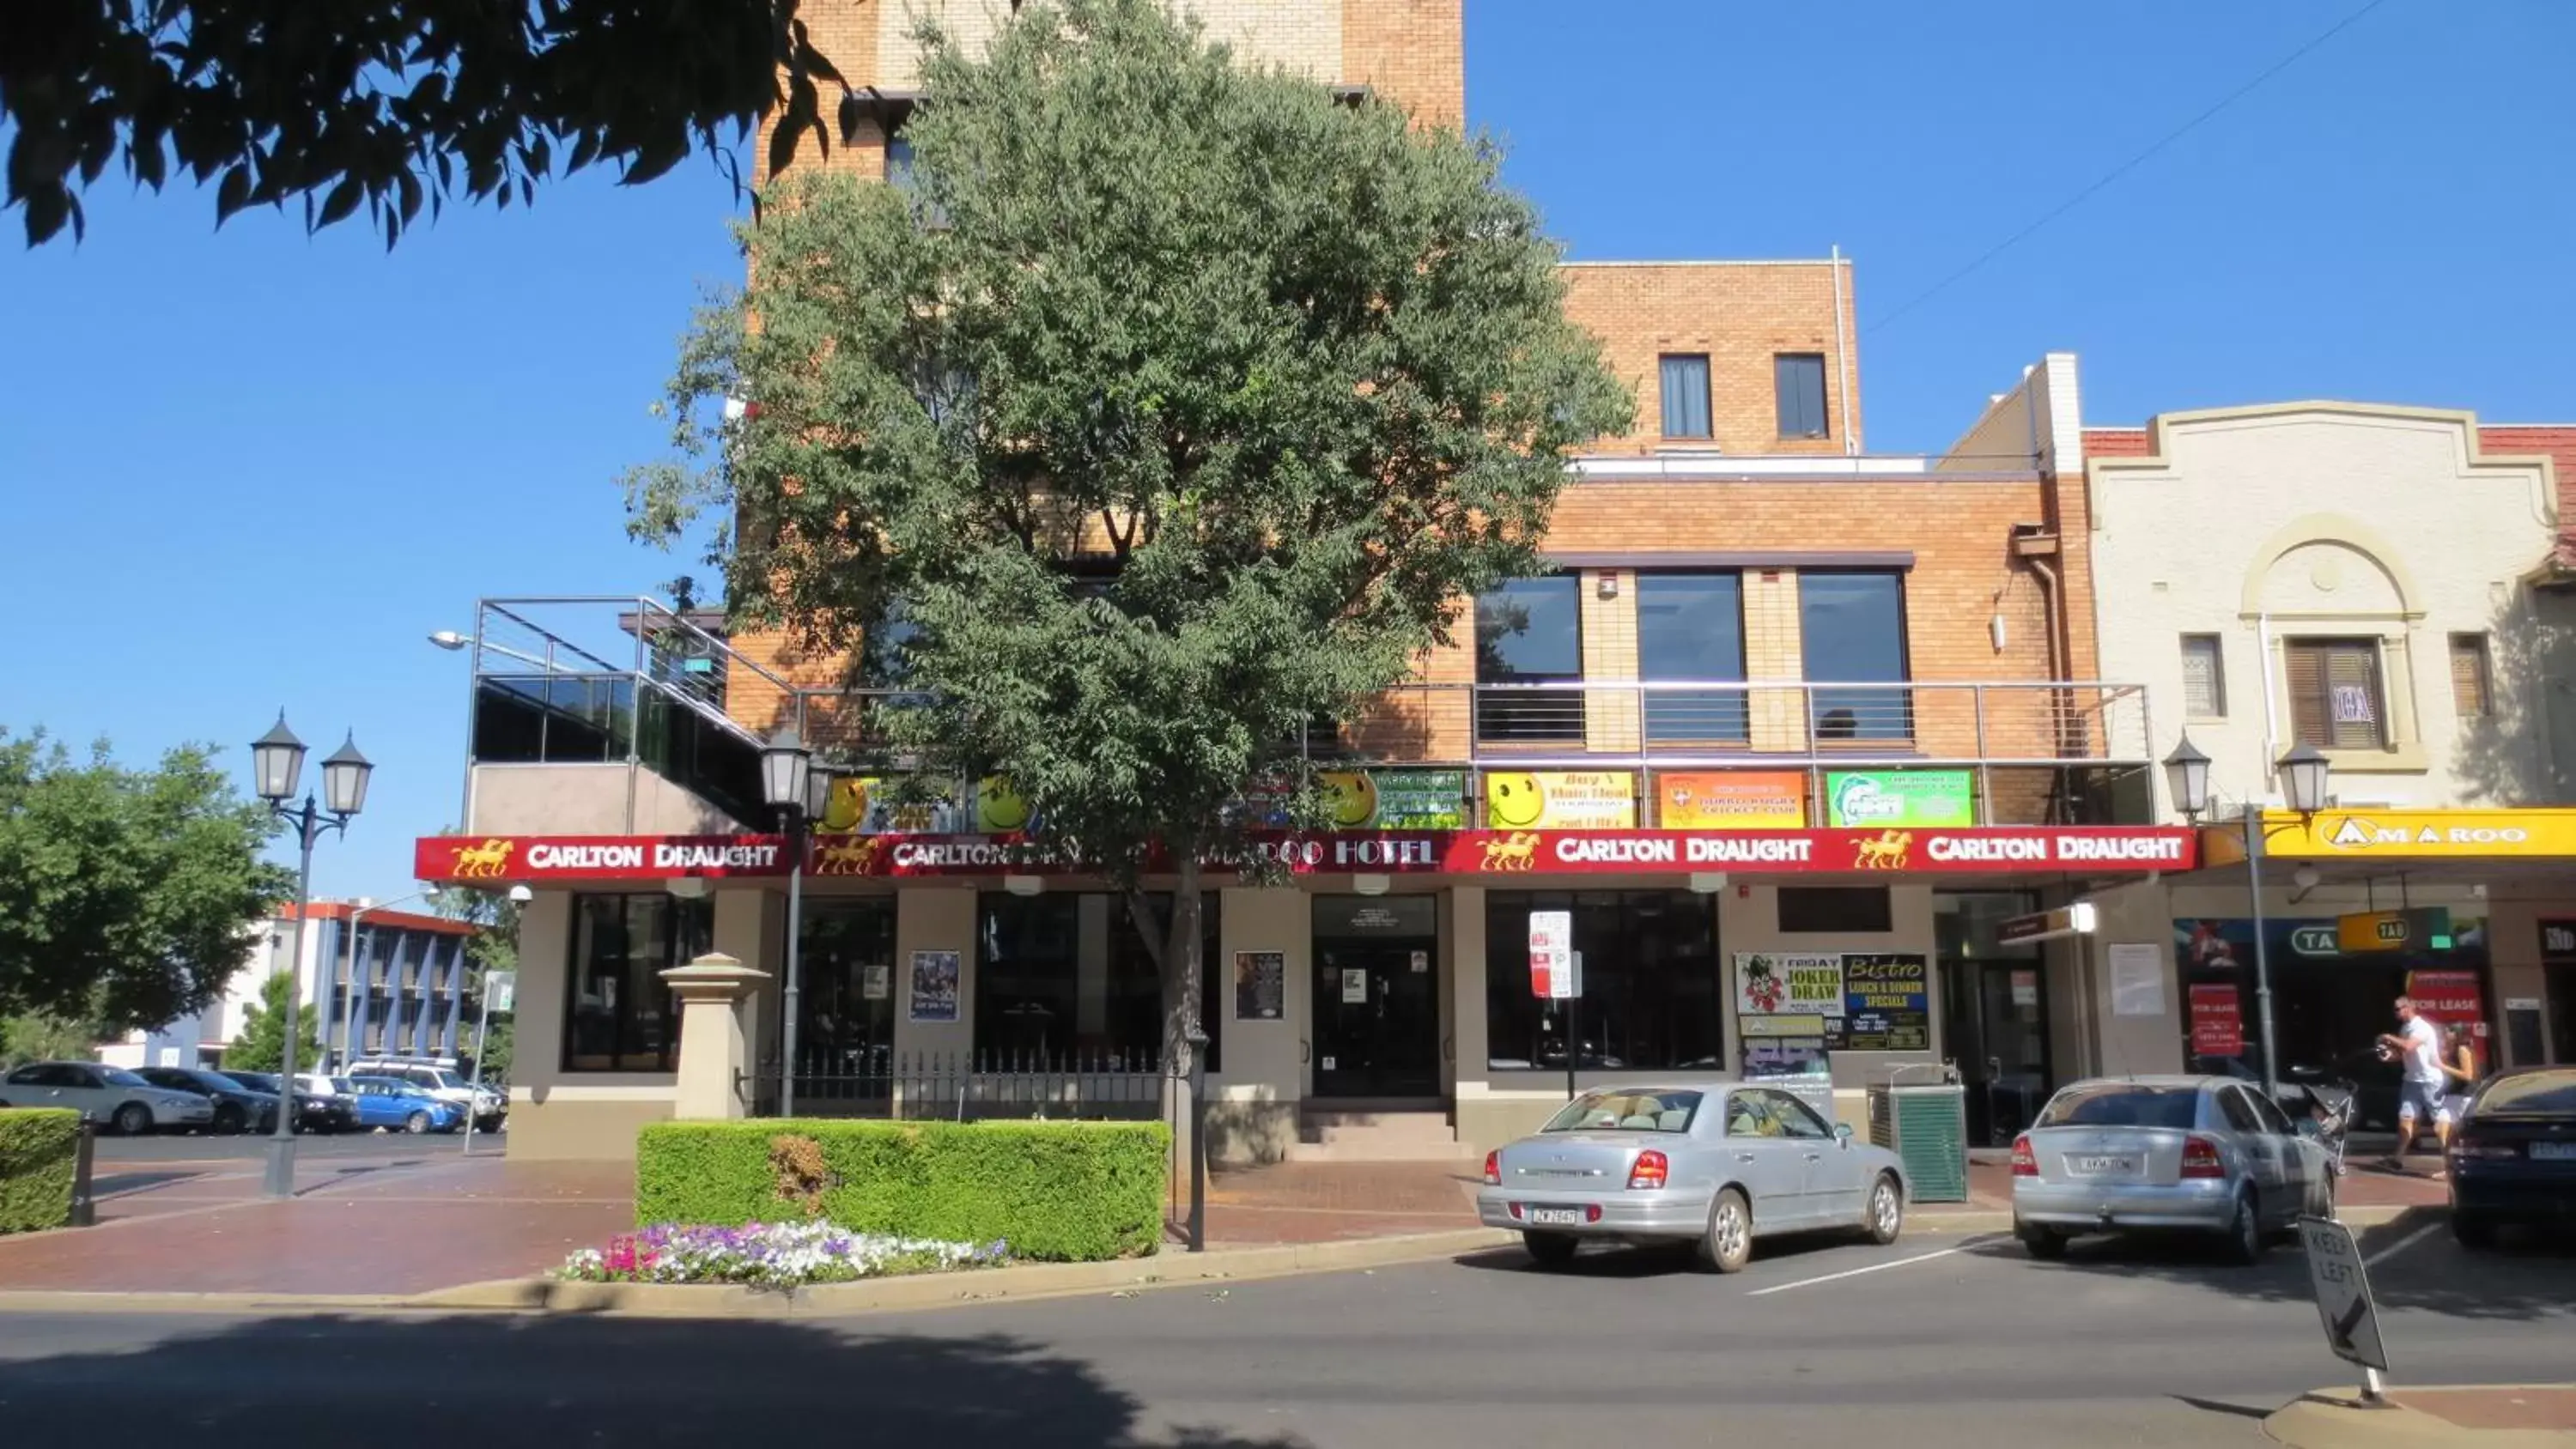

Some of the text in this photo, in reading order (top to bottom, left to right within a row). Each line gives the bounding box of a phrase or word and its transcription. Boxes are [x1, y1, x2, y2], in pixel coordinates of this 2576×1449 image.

[1564, 774, 1600, 785] Buy
[1551, 787, 1629, 798] Main Meal
[893, 842, 1008, 866] CARLTON
[1336, 840, 1439, 864] HOTEL
[1555, 838, 1813, 862] CARLTON DRAUGHT
[1928, 837, 2182, 860] CARLTON DRAUGHT
[527, 845, 777, 868] CARLTON DRAUGHT
[2379, 923, 2405, 937] TAB
[1788, 959, 1838, 967] FRIDAY
[1848, 956, 1923, 979] Bistro
[1785, 970, 1840, 985] JOKER
[1791, 985, 1838, 1000] DRAW
[1849, 981, 1878, 993] LUNCH
[1890, 981, 1923, 993] DINNER
[1865, 995, 1908, 1007] SPECIALS
[2440, 998, 2476, 1010] LEASE
[2309, 1229, 2348, 1256] KEEP
[2318, 1260, 2355, 1286] LEFT
